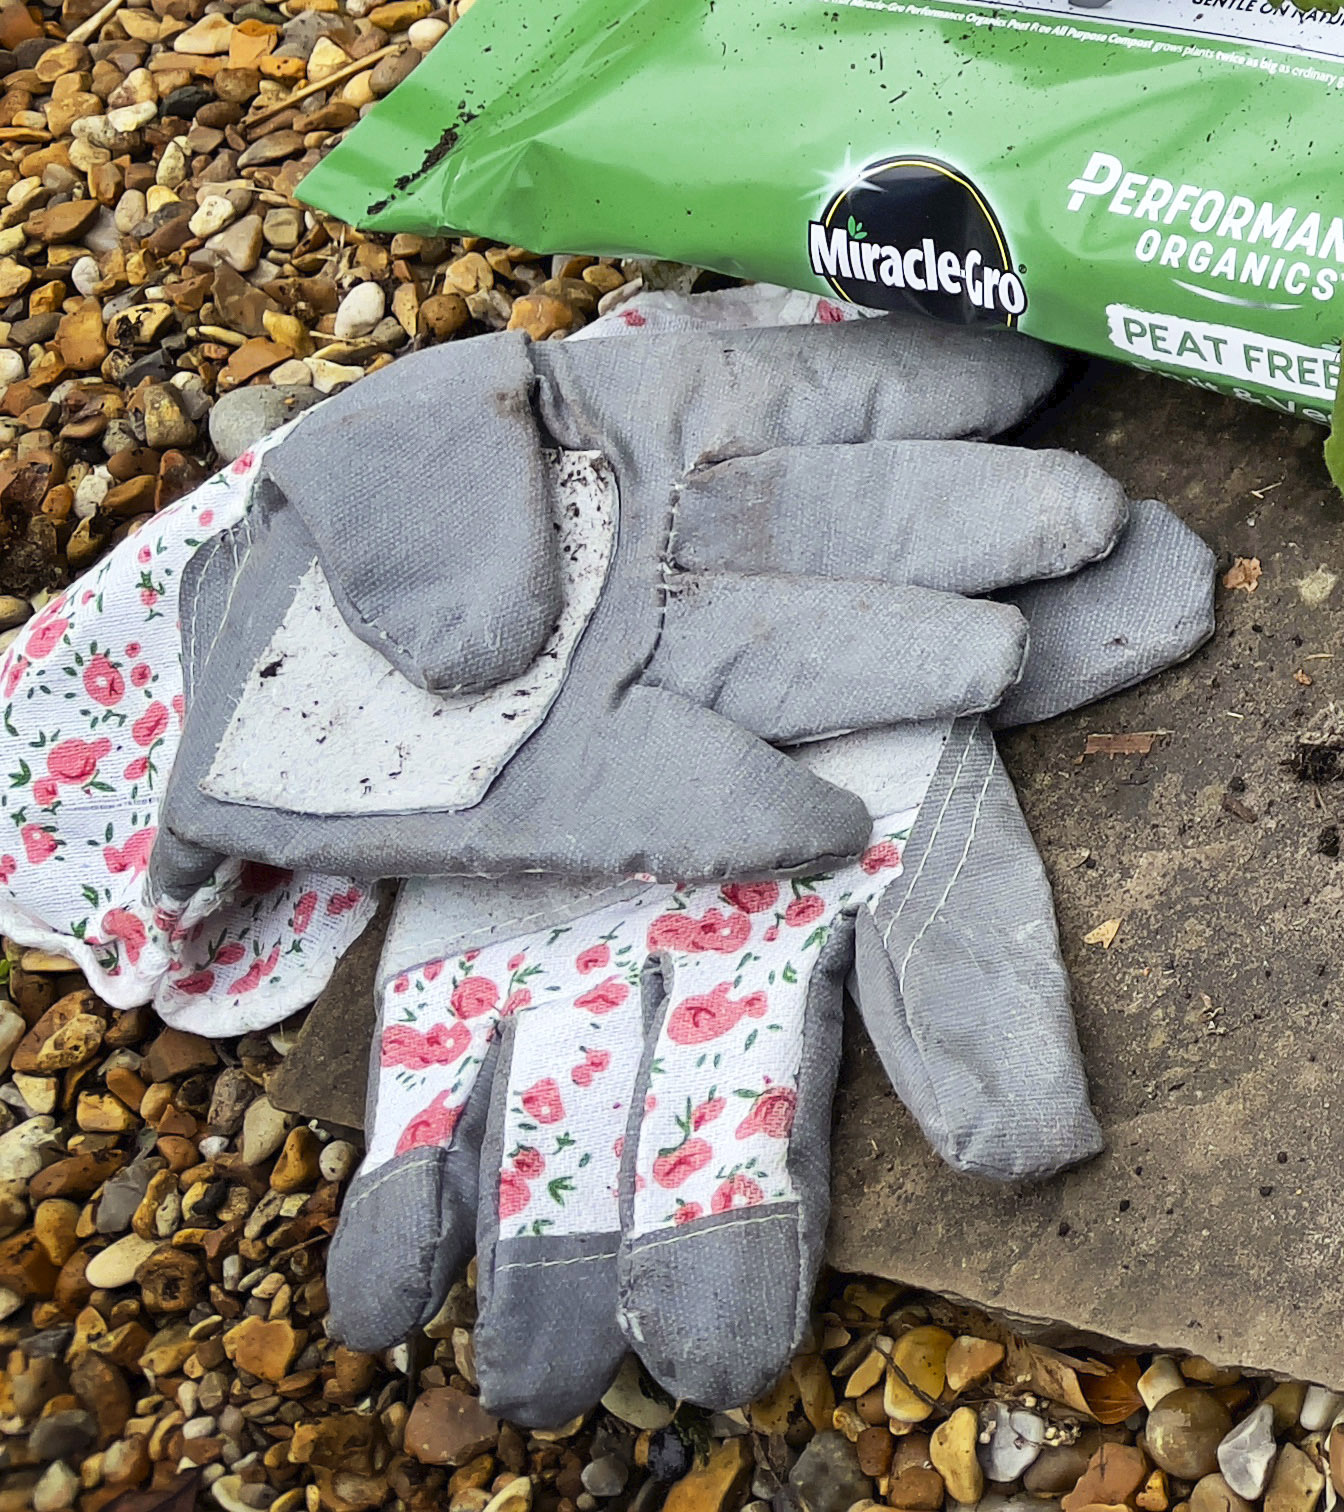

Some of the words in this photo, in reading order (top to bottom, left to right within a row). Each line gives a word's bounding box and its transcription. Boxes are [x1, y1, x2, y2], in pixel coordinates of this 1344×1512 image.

[1007, 19, 1031, 31] Peat
[1050, 25, 1067, 37] All
[1066, 27, 1108, 43] Purpose
[1108, 33, 1154, 49] Compost
[1152, 41, 1183, 53] grows
[1181, 44, 1215, 58] plants
[1215, 50, 1246, 64] twice
[1245, 57, 1259, 67] as
[1259, 56, 1279, 75] big
[1278, 63, 1291, 74] as
[1291, 67, 1337, 86] ordinary
[810, 223, 1025, 315] Miracle-Gro
[1122, 316, 1227, 365] PEAT
[1243, 343, 1340, 390] FREE
